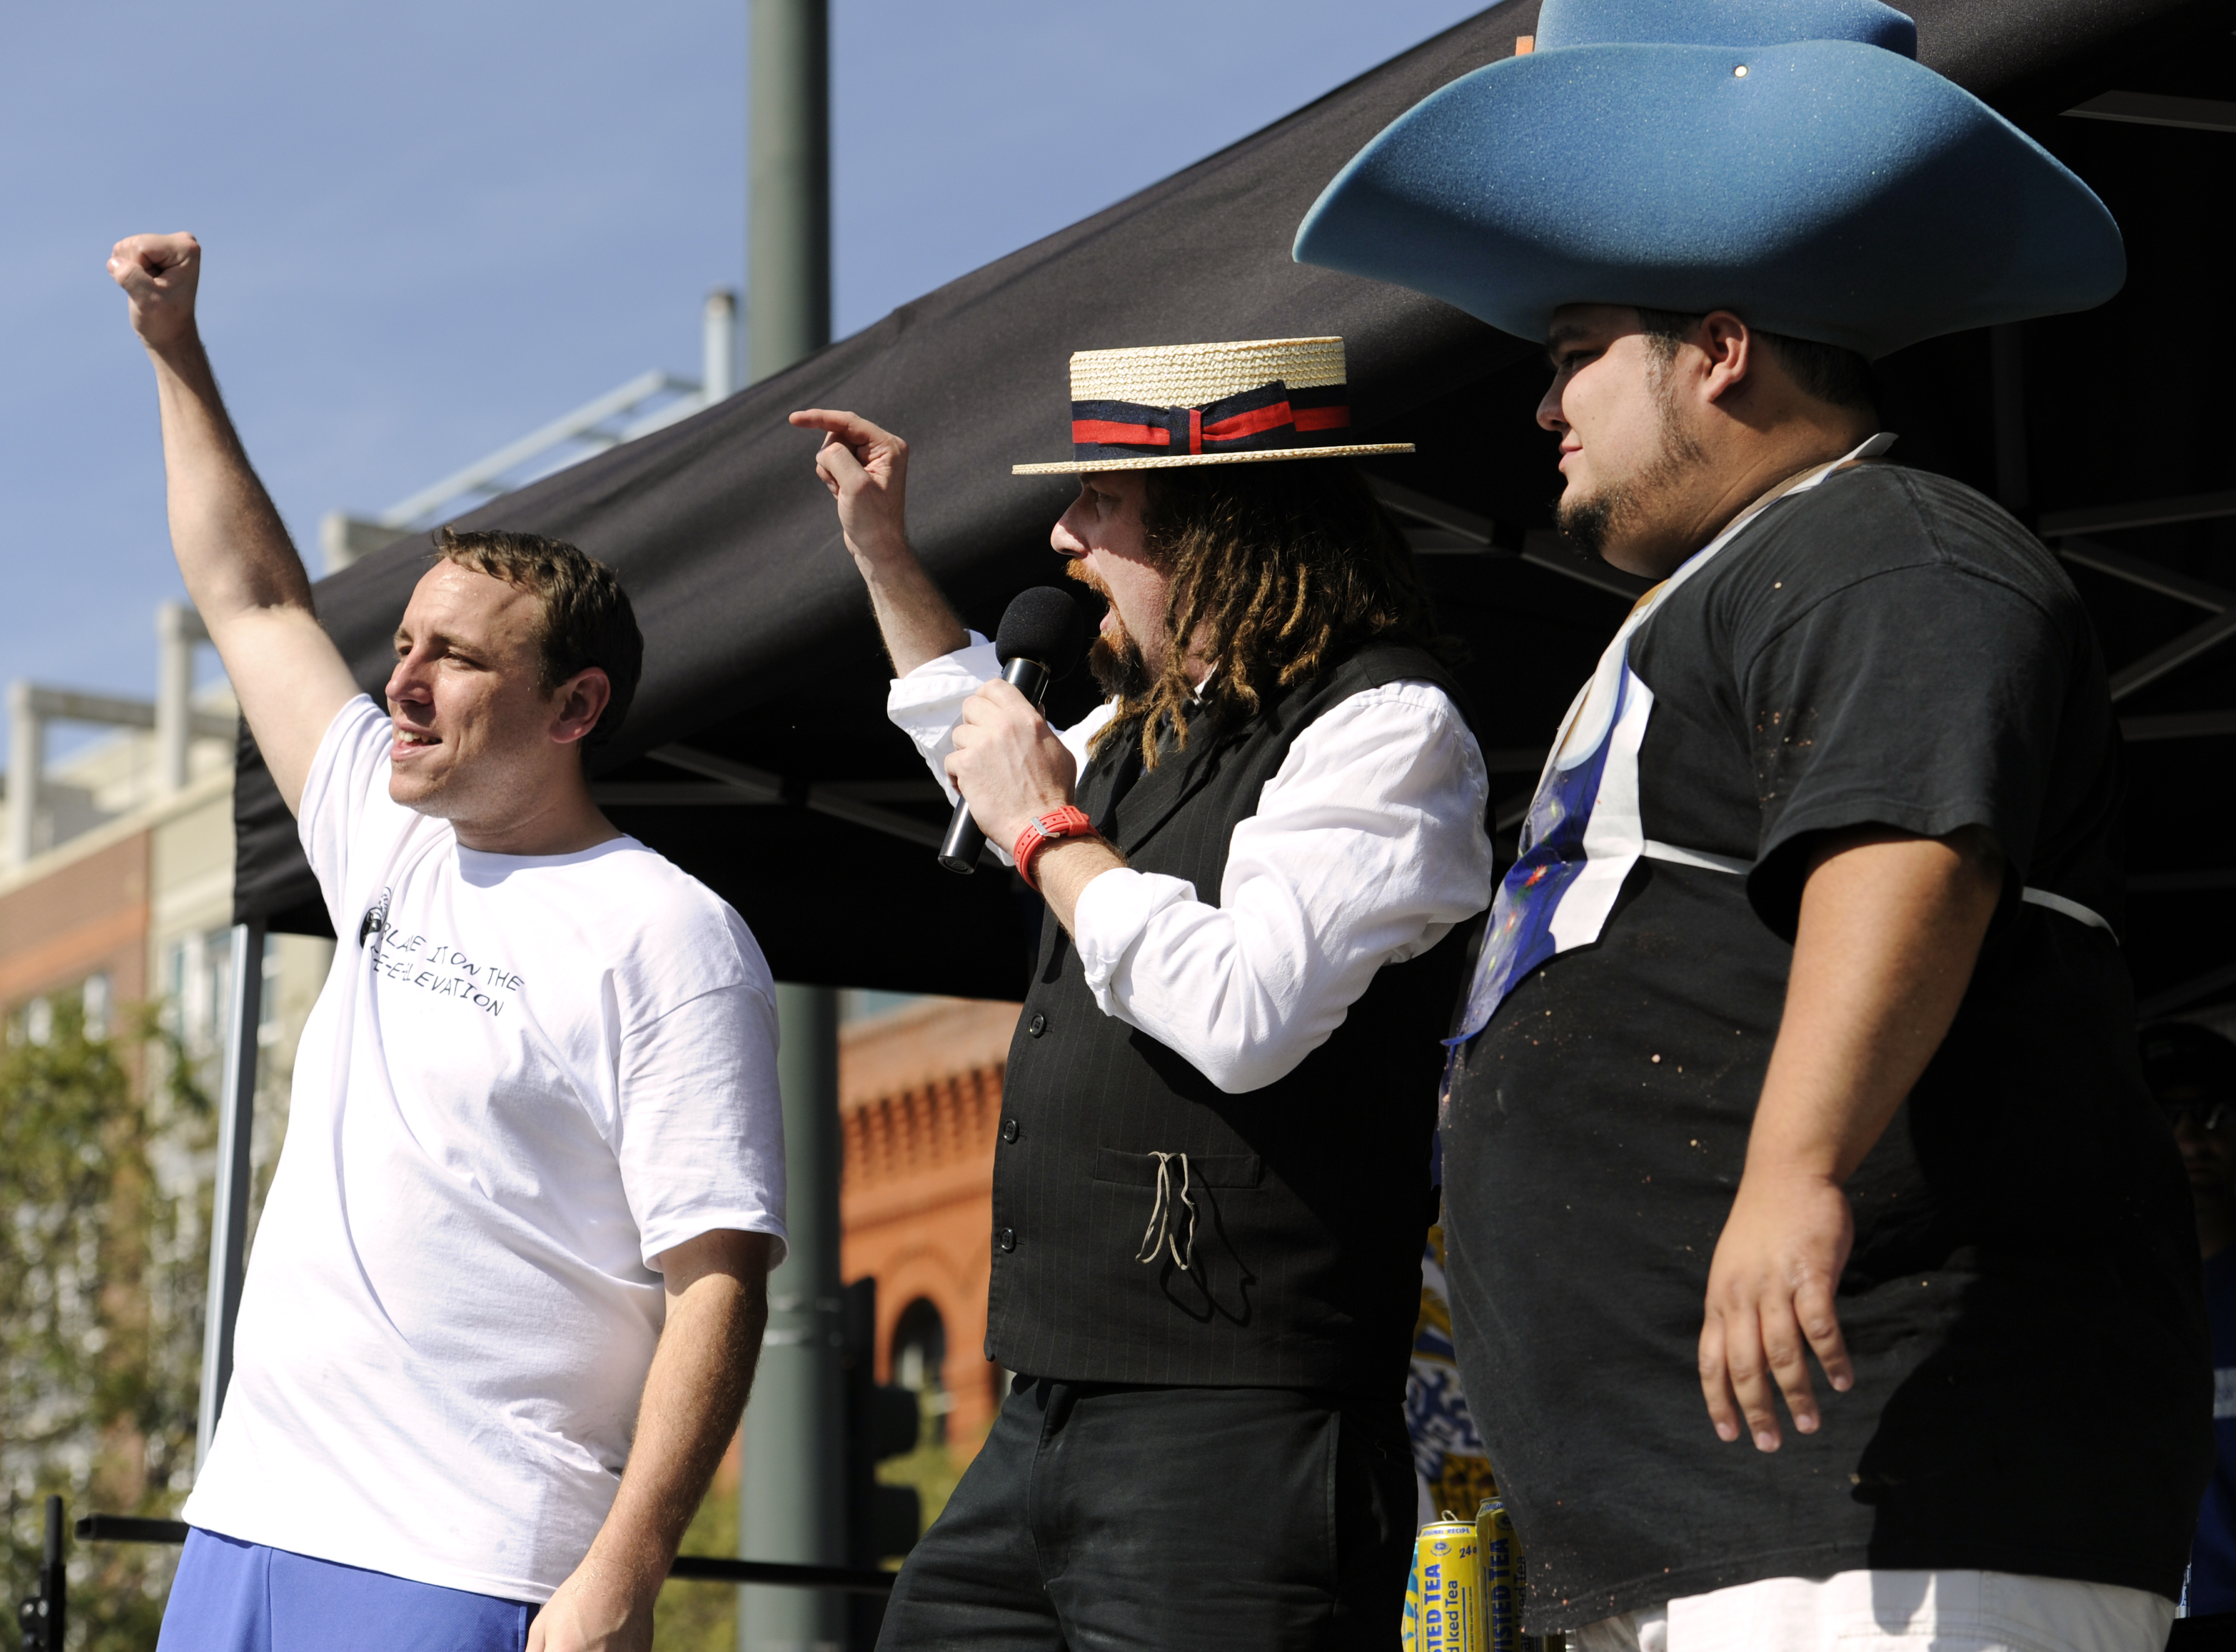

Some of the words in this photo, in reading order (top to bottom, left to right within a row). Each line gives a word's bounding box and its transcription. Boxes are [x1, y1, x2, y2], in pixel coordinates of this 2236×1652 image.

[426, 946, 449, 964] IT
[450, 952, 481, 976] ON
[487, 966, 525, 991] THE
[1460, 1545, 1472, 1559] 24
[1489, 1538, 1510, 1582] TEA
[1425, 1563, 1441, 1606] TEA
[1445, 1580, 1459, 1608] Tea
[1446, 1612, 1460, 1641] Iced
[1492, 1585, 1513, 1652] ISTED
